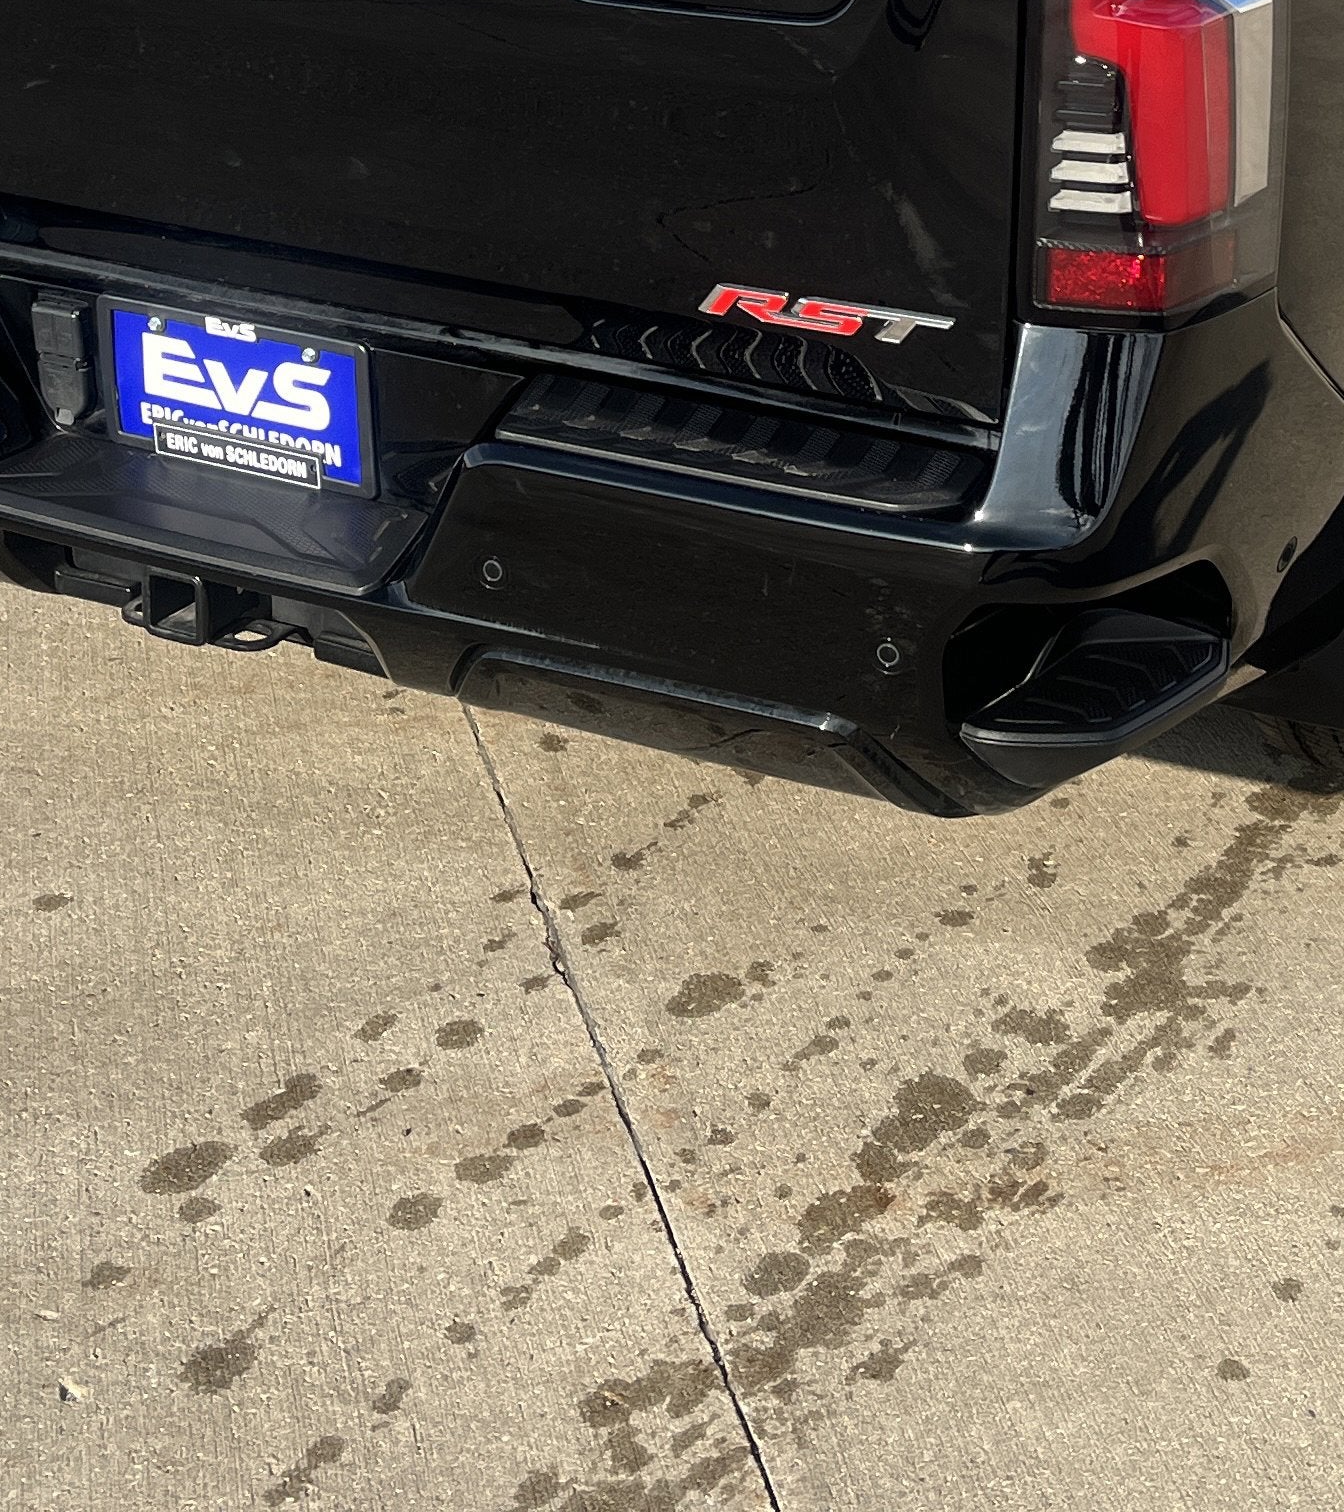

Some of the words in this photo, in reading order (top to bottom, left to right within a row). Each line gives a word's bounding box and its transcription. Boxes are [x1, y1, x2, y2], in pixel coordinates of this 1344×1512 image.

[698, 283, 956, 344] RST
[166, 432, 198, 454] ERIC
[201, 443, 224, 460] von
[226, 445, 307, 478] SCHLEDORN
